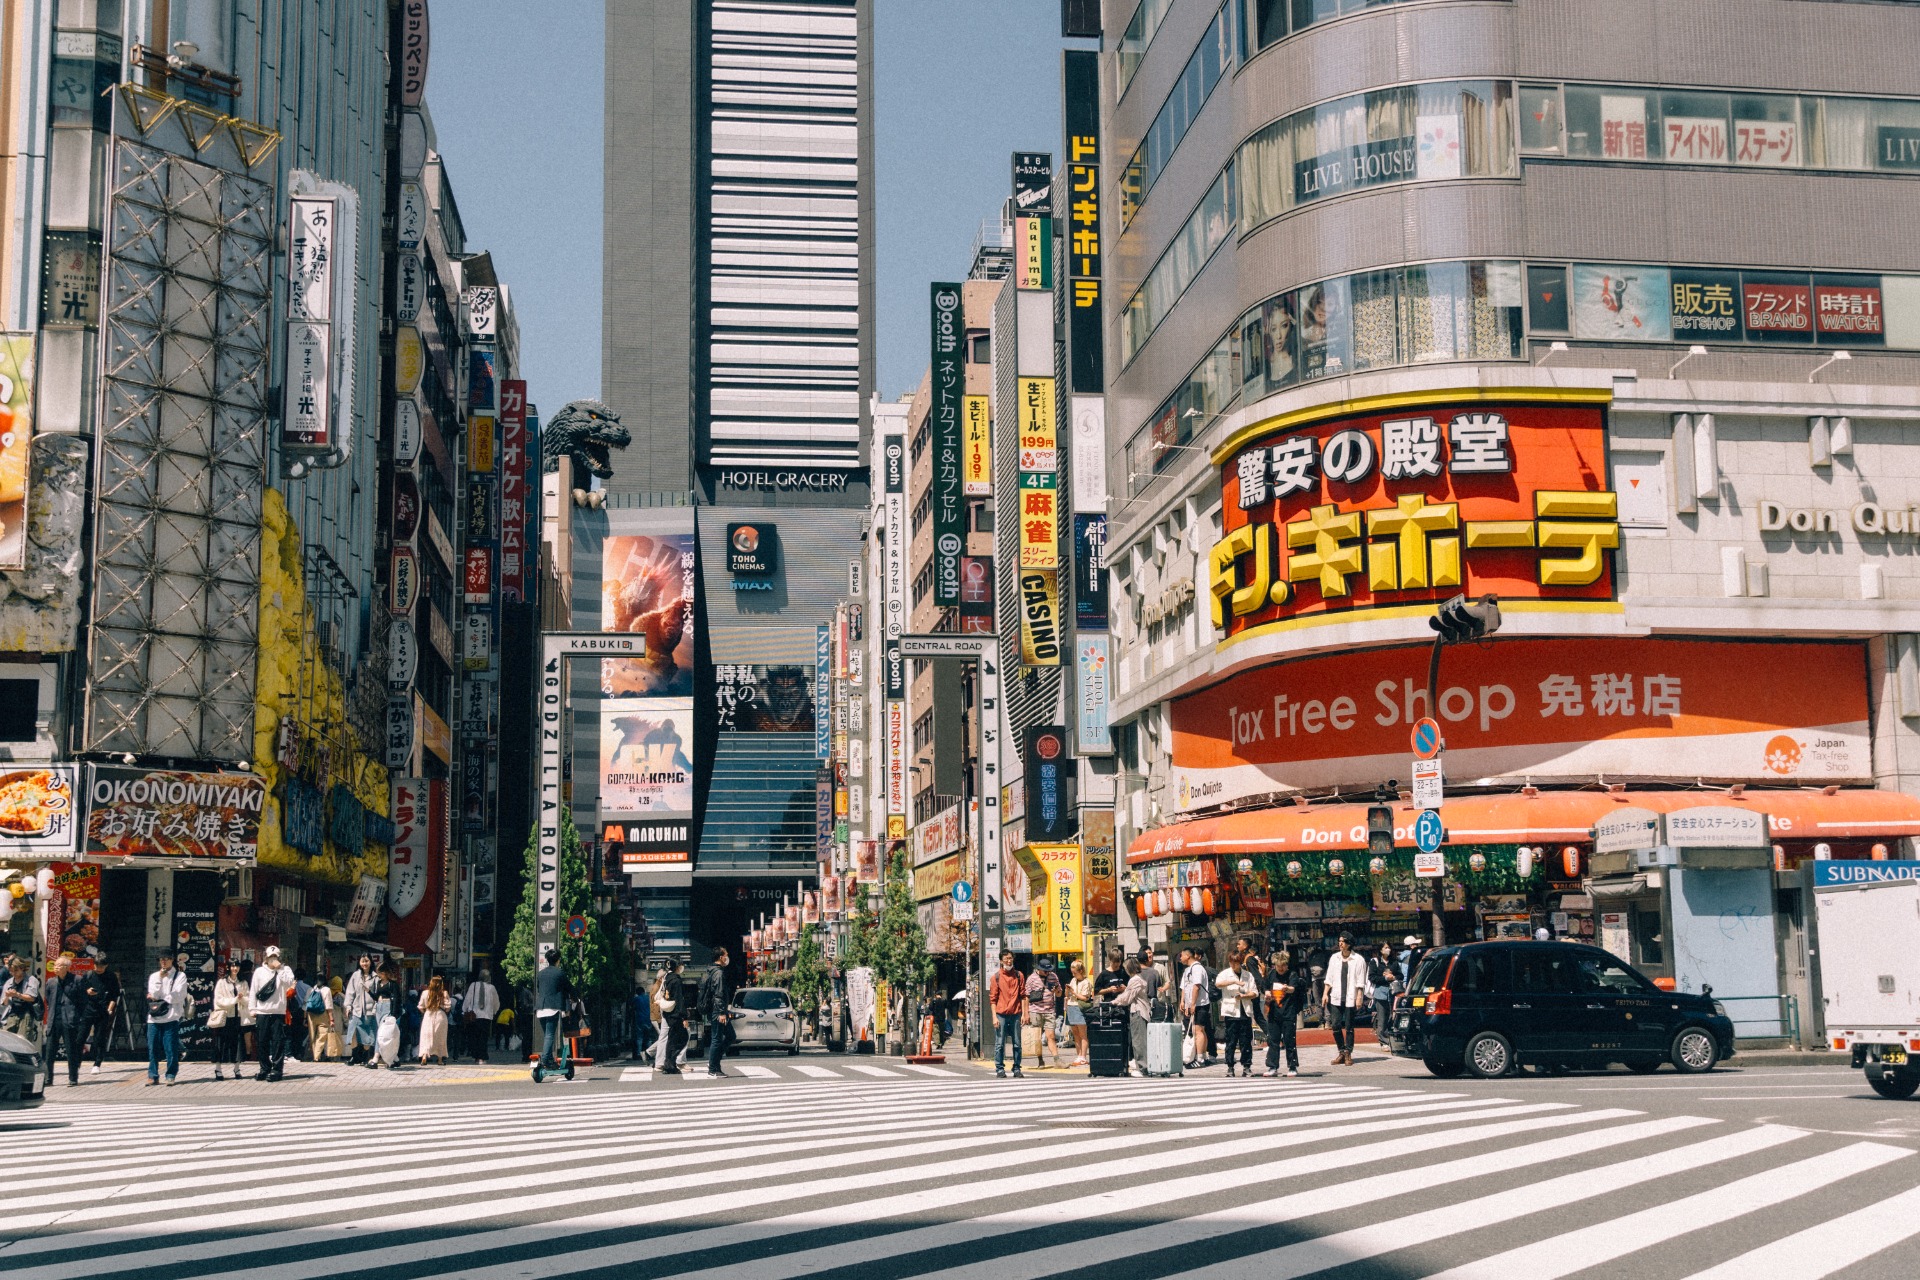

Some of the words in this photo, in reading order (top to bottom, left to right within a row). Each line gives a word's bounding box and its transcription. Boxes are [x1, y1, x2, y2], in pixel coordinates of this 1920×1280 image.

[1603, 119, 1647, 158] 新宿
[1668, 123, 1725, 160] アイドル
[1737, 127, 1794, 163] ステージ
[1303, 161, 1343, 194] LIVE
[1353, 149, 1415, 180] HOUSE
[1028, 221, 1040, 274] Garam
[61, 291, 88, 320] 光
[400, 310, 416, 320] 6F
[475, 290, 490, 330] ダーツ
[1673, 283, 1735, 316] 販売
[1747, 292, 1807, 312] ブランド
[1819, 294, 1879, 315] 時計
[935, 289, 959, 352] Booth
[1750, 312, 1808, 329] BRAND
[1821, 314, 1880, 331] WATCH
[298, 396, 314, 415] 光
[970, 401, 981, 441] 生ビール
[1027, 382, 1041, 432] 生ビール
[1021, 436, 1054, 448] 199円
[886, 444, 901, 486] Booth
[1236, 412, 1511, 511] 驚安の殿堂
[501, 388, 522, 576] カラオケ歌広場
[722, 472, 772, 484] HOTEL
[776, 472, 848, 486] GRACERY
[1026, 474, 1050, 488] 4F
[1024, 493, 1053, 544] 麻雀
[1759, 499, 1838, 532] Don
[732, 555, 756, 563] TOHO
[938, 533, 962, 599] Booth
[1023, 547, 1048, 555] スリー
[730, 580, 773, 590] IMAX
[852, 566, 860, 594] 東京ビル
[1021, 574, 1059, 661] CASINO
[905, 642, 951, 650] CENTRAL
[955, 642, 982, 650] ROAD
[470, 659, 483, 668] 3F
[887, 647, 902, 690] Booth
[1085, 674, 1095, 714] STAGE
[1094, 675, 1104, 707] IDOL
[1538, 672, 1682, 719] 免税店
[818, 671, 829, 754] カラオケランド
[1229, 705, 1265, 748] Tax
[1275, 694, 1357, 738] Free
[1374, 677, 1516, 731] Shop
[543, 676, 559, 811] GODZILLA
[890, 711, 901, 749] カラオケ
[390, 752, 404, 761] B1
[1811, 751, 1849, 761] Tax-free
[1825, 762, 1849, 773] Shop
[46, 772, 69, 838] かつ丼
[95, 779, 265, 812] OKONOMIYAKI
[416, 780, 428, 827] 大衆酒場
[1190, 786, 1202, 799] Don
[1202, 780, 1223, 798] Quijote
[101, 806, 249, 843] お好み焼き
[394, 786, 415, 865] トラノコ
[630, 826, 687, 843] MARUHAN
[818, 790, 831, 846] カラオケ
[1420, 820, 1432, 847] P
[1600, 820, 1652, 837] 安全安心ステーショ
[1672, 817, 1757, 829] 安全安心ステーション
[1301, 827, 1342, 844] Don
[1427, 834, 1437, 846] 40
[540, 826, 556, 892] ROAD
[1041, 851, 1077, 861] カラオケ
[751, 889, 782, 899] TOHO
